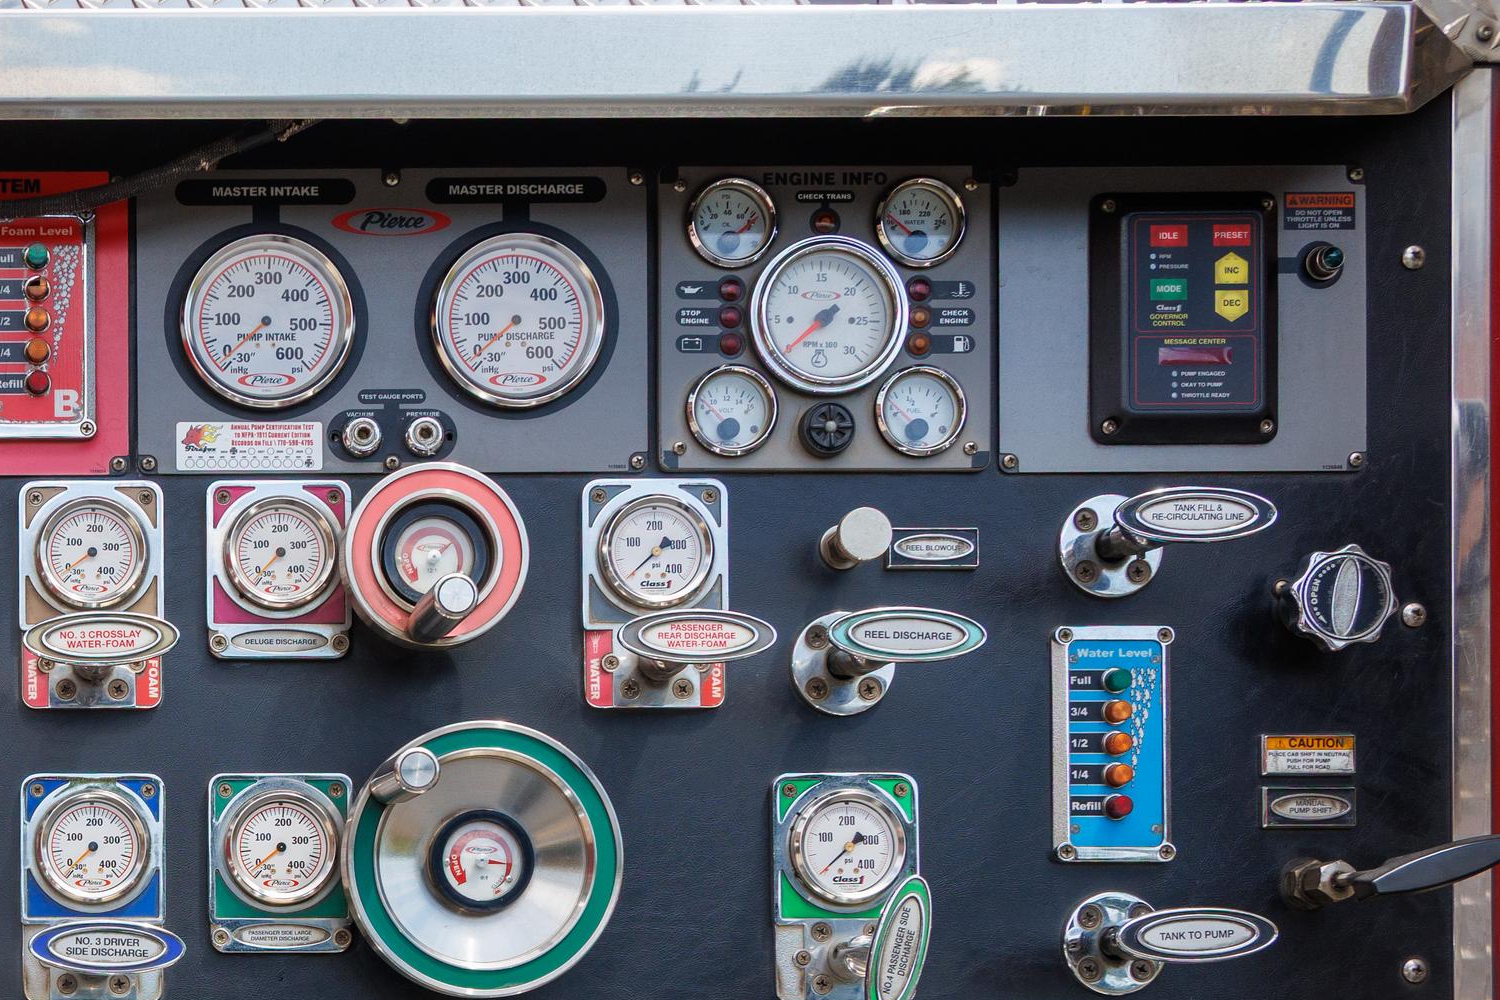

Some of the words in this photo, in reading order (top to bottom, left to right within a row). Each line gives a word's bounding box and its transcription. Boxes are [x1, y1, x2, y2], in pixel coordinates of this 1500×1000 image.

[764, 172, 836, 186] ENGINE
[842, 172, 887, 186] INFO
[212, 186, 267, 197] MASTER
[270, 185, 319, 197] INTAKE
[448, 184, 504, 195] MASTER
[506, 183, 584, 195] DISCHARGE
[1299, 195, 1352, 205] WARNING
[360, 211, 425, 231] Pierce
[1, 226, 36, 236] Foam
[39, 226, 73, 236] Level
[1158, 231, 1179, 240] IDLE
[1214, 231, 1248, 239] PRESET
[1224, 266, 1240, 274] INC
[254, 271, 283, 285] 300
[1156, 284, 1182, 293] MODE
[281, 288, 310, 302] 400
[1222, 299, 1241, 307] DEC
[941, 309, 969, 317] CHECK
[289, 317, 318, 332] 500
[680, 317, 709, 325] ENGINE
[55, 389, 80, 417] B
[1173, 503, 1196, 512] TANK
[1197, 503, 1215, 512] FILL
[1217, 503, 1223, 512] &
[1152, 512, 1223, 521] RE-CIRCULATING
[1225, 512, 1244, 521] LINE
[670, 623, 723, 631] PASSENGER
[60, 631, 77, 639] NO.
[80, 631, 86, 639] 3
[88, 630, 142, 639] CROSSLAY
[657, 632, 682, 640] REAR
[684, 632, 736, 640] DISCHARGE
[864, 630, 890, 639] REEL
[893, 631, 953, 640] DISCHARGE
[67, 639, 135, 649] WATER-FOAM
[275, 638, 317, 646] DISCHARGE
[667, 640, 727, 648] WATER-FOAM
[1077, 648, 1116, 658] Water
[1118, 648, 1152, 658] Level
[1070, 675, 1092, 685] Full
[1070, 707, 1089, 717] 3/4
[1071, 738, 1089, 748] 1/2
[1288, 737, 1345, 749] CAUTION
[1071, 769, 1089, 779] 1/4
[1071, 801, 1101, 811] Refill
[1159, 931, 1186, 941] TANK
[1187, 930, 1203, 940] TO
[1204, 929, 1235, 939] PUMP
[75, 937, 93, 946] NO.
[95, 937, 102, 946] 3
[103, 938, 140, 946] DRIVER
[887, 927, 905, 975] PASSENGER
[900, 907, 911, 926] SIDE
[66, 947, 88, 957] SIDE
[91, 948, 149, 959] DISCHARGE
[898, 929, 916, 976] DISCHARGE
